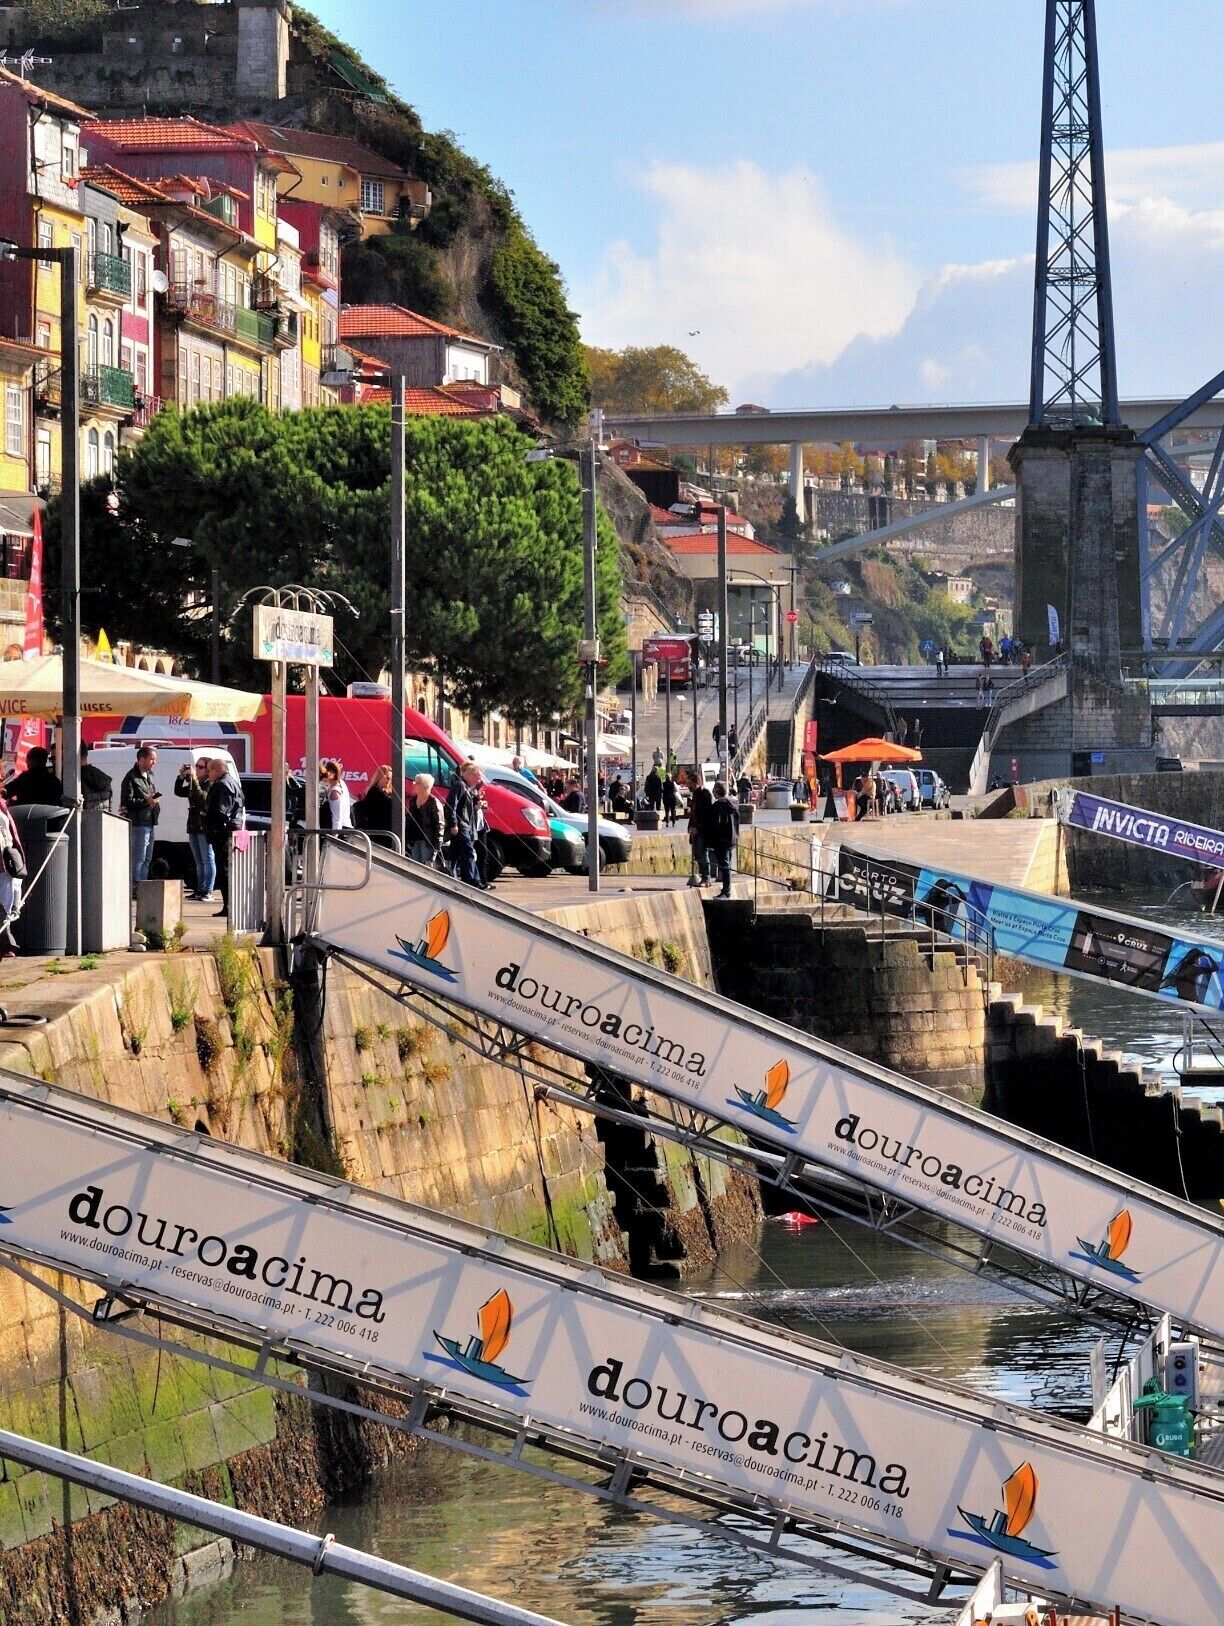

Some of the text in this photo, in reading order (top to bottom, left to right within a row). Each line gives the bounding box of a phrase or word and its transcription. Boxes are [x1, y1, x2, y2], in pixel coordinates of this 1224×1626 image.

[853, 866, 897, 885] PORTO
[1093, 807, 1170, 846] INVICTA
[1173, 830, 1224, 854] RIBEIRA
[840, 873, 906, 906] CRUZ
[1048, 925, 1061, 934] Cruz
[1124, 939, 1149, 951] CRUZ
[487, 989, 556, 1026] www.douroacima.pt
[561, 1023, 644, 1065] reservas@douroacima.pt
[657, 1064, 670, 1077] 222
[671, 1070, 685, 1083] 006
[686, 1077, 700, 1090] 418
[495, 962, 707, 1077] douroacima
[827, 1141, 896, 1177] www.douroacima.pt
[902, 1173, 985, 1216] reservas@douroacima.pt
[997, 1215, 1011, 1228] 222
[1013, 1221, 1026, 1234] 006
[1027, 1227, 1041, 1241] 418
[834, 1113, 1048, 1227] douroacima
[60, 1229, 162, 1272] www.douroacima.pt
[171, 1265, 295, 1316] reservas@douroacima.pt
[314, 1311, 335, 1329] 222
[337, 1318, 357, 1336] 006
[359, 1326, 379, 1343] 418
[68, 1185, 386, 1323] douroacima
[579, 1400, 683, 1446] www.douroacima.pt
[691, 1440, 818, 1492] reservas@douroacima.pt
[837, 1487, 858, 1506] 222
[860, 1495, 880, 1513] 006
[883, 1502, 904, 1519] 418
[587, 1357, 910, 1499] douroacima
